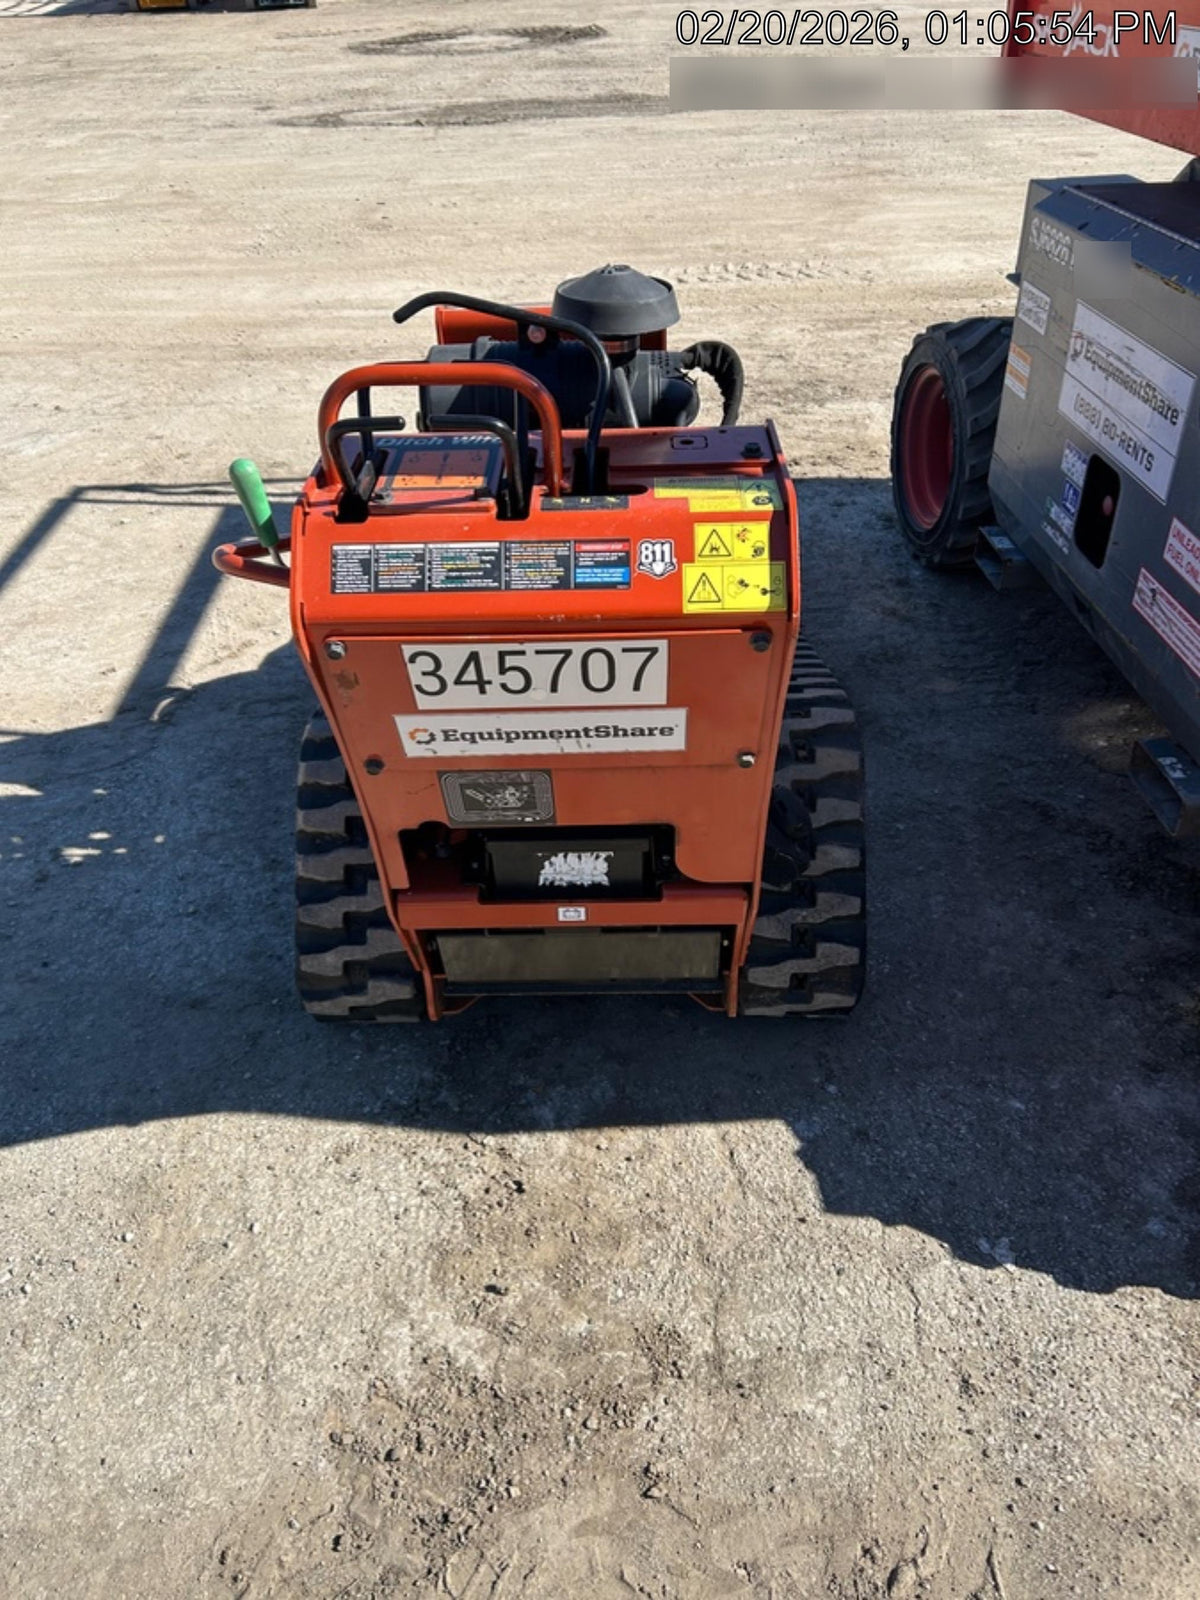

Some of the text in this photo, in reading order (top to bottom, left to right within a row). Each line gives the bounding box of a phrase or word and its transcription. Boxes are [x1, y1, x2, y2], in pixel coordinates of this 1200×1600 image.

[641, 542, 671, 563] 811
[408, 646, 659, 698] 345707
[440, 725, 675, 745] EquipmentShare
